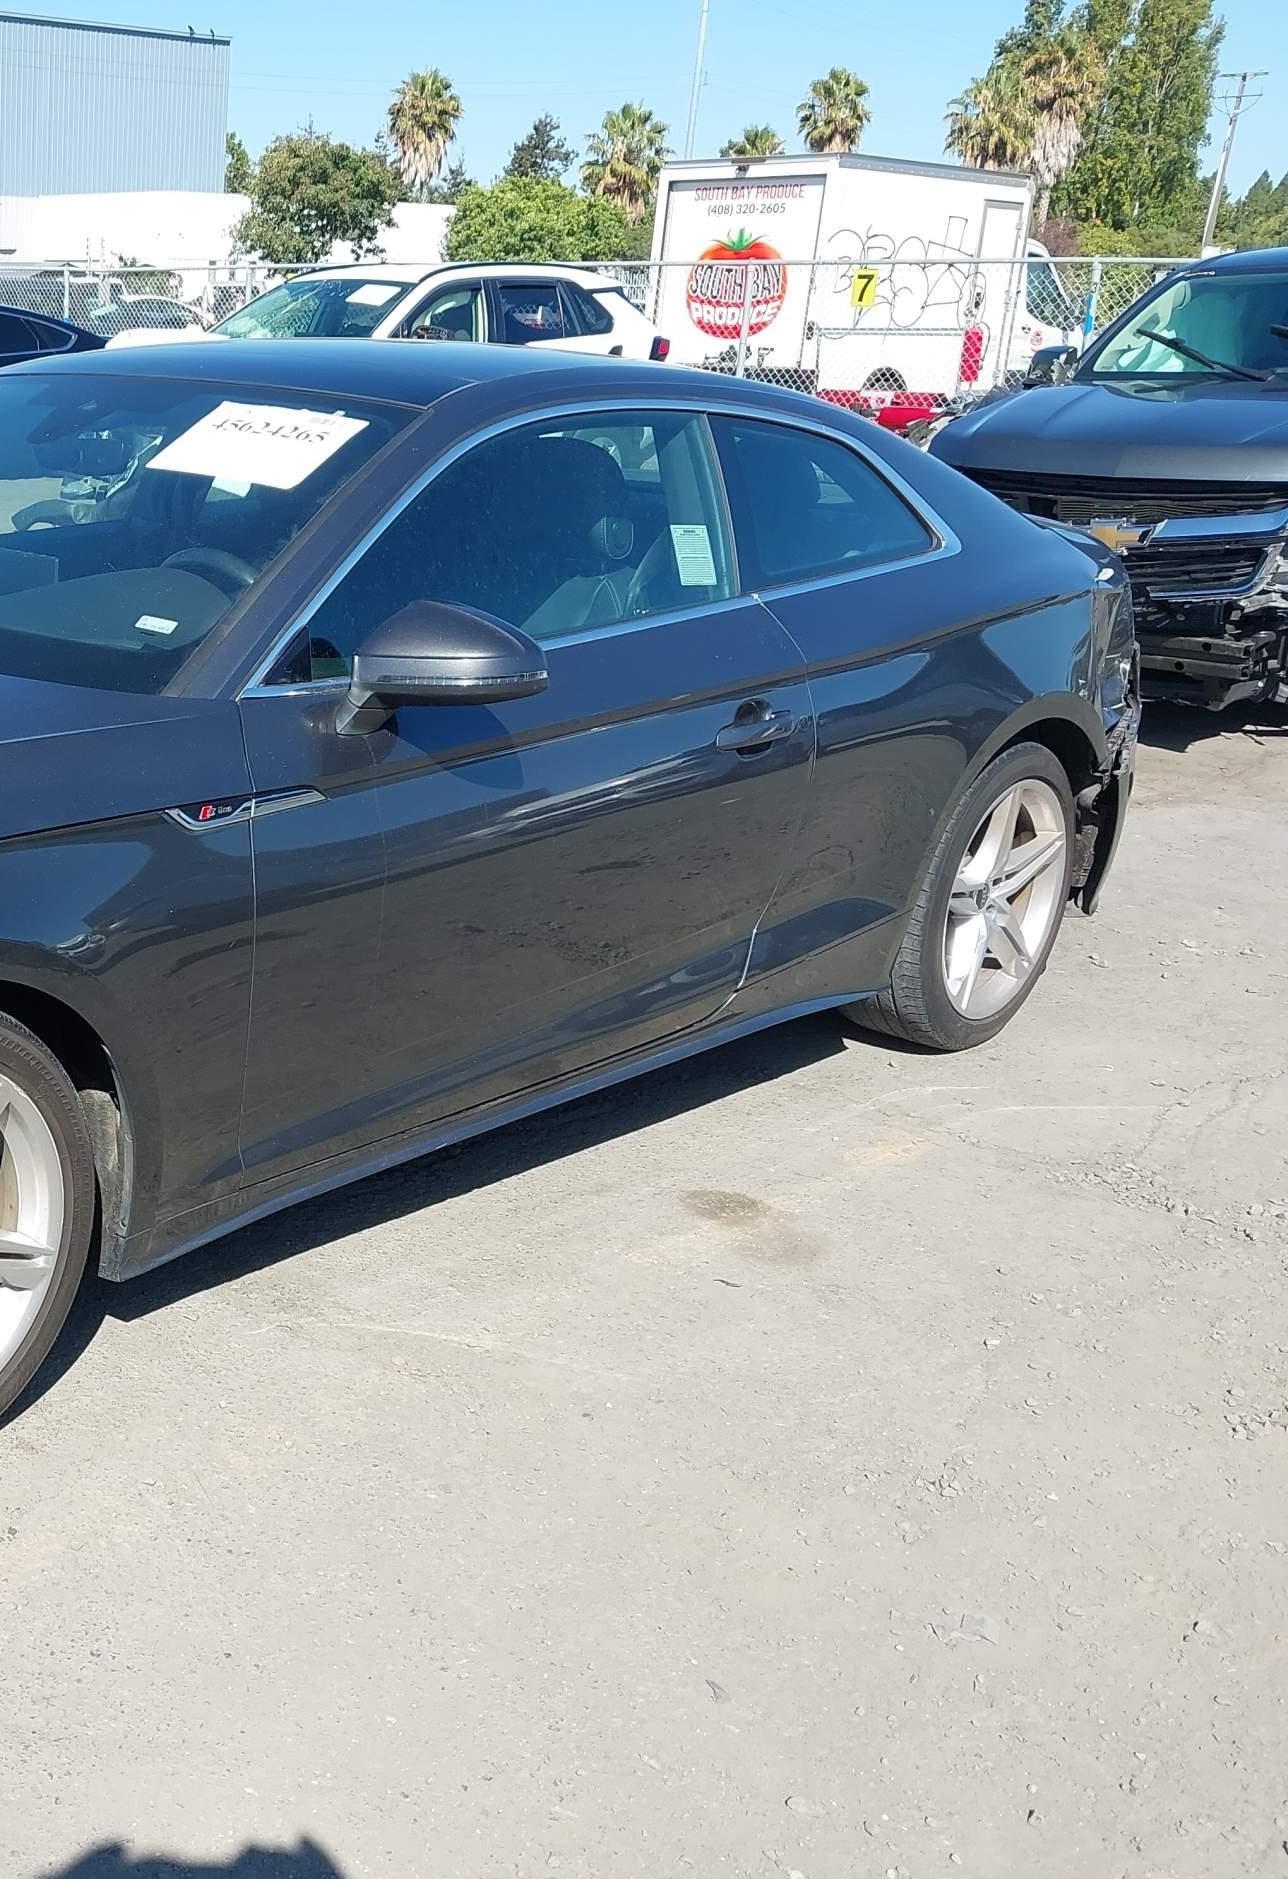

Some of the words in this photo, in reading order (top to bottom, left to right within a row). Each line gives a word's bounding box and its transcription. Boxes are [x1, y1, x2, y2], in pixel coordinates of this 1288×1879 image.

[695, 187, 728, 201] SOUTH
[731, 185, 754, 200] BAY
[756, 184, 806, 199] PRODUCE
[707, 204, 734, 216] (408)
[736, 203, 787, 214] 320-2605
[857, 274, 875, 302] 7
[690, 301, 783, 326] PRODCE
[212, 418, 331, 443] 45624265
